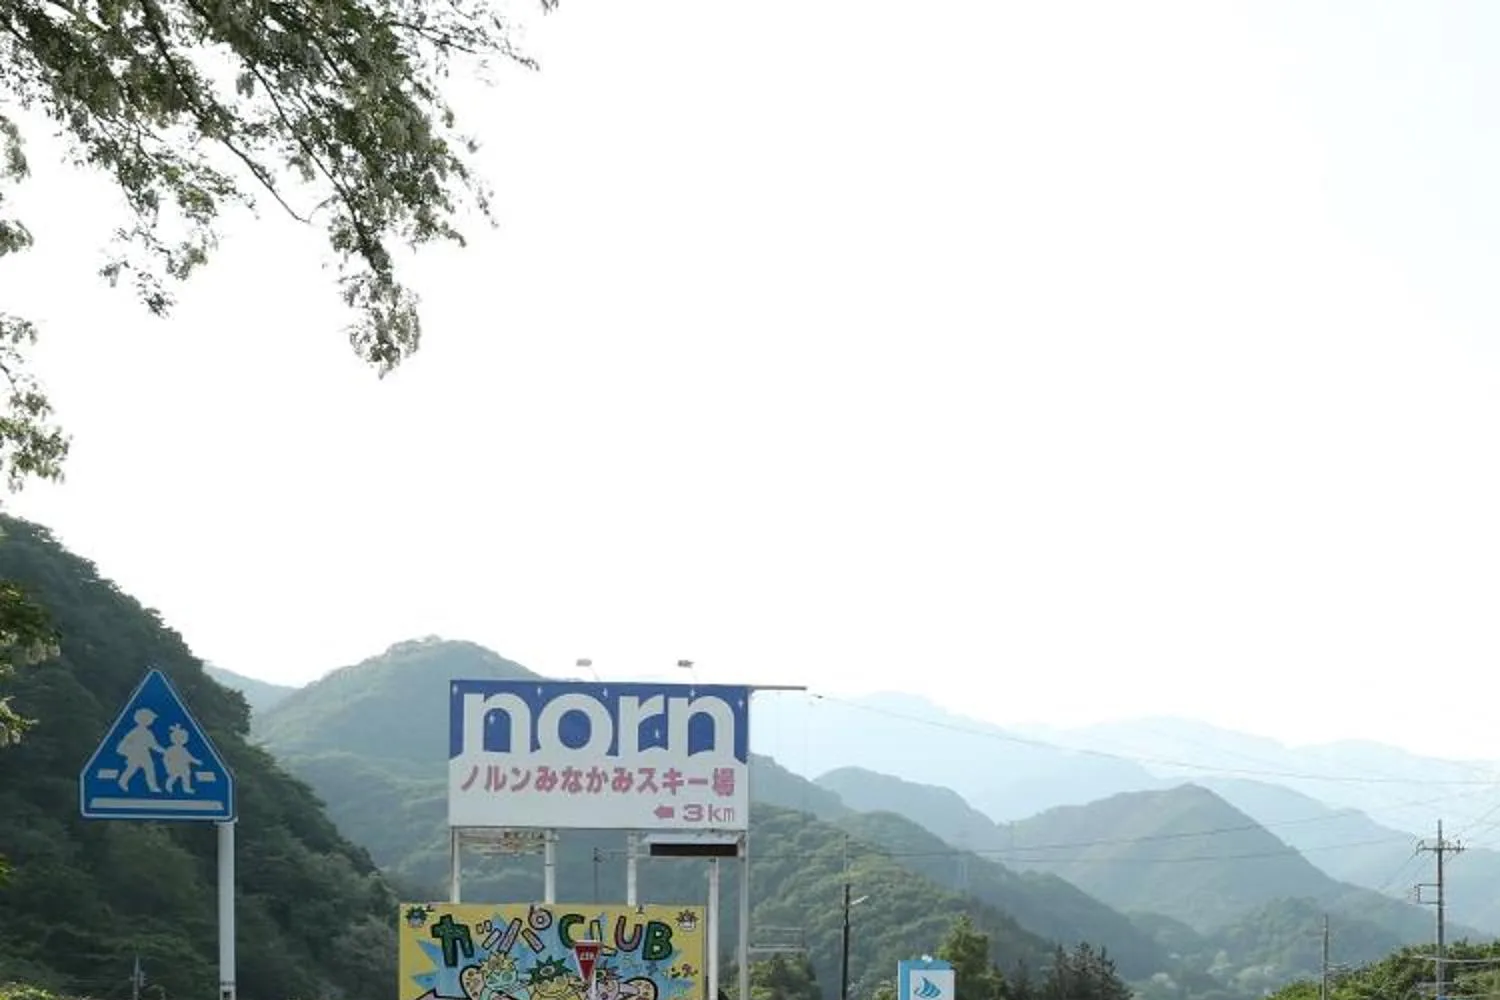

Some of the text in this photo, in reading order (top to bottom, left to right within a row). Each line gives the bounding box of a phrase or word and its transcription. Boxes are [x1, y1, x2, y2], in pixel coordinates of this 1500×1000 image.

[463, 692, 736, 757] norn
[461, 765, 735, 797] ノルンみなかみスキー場
[682, 803, 735, 822] 3km
